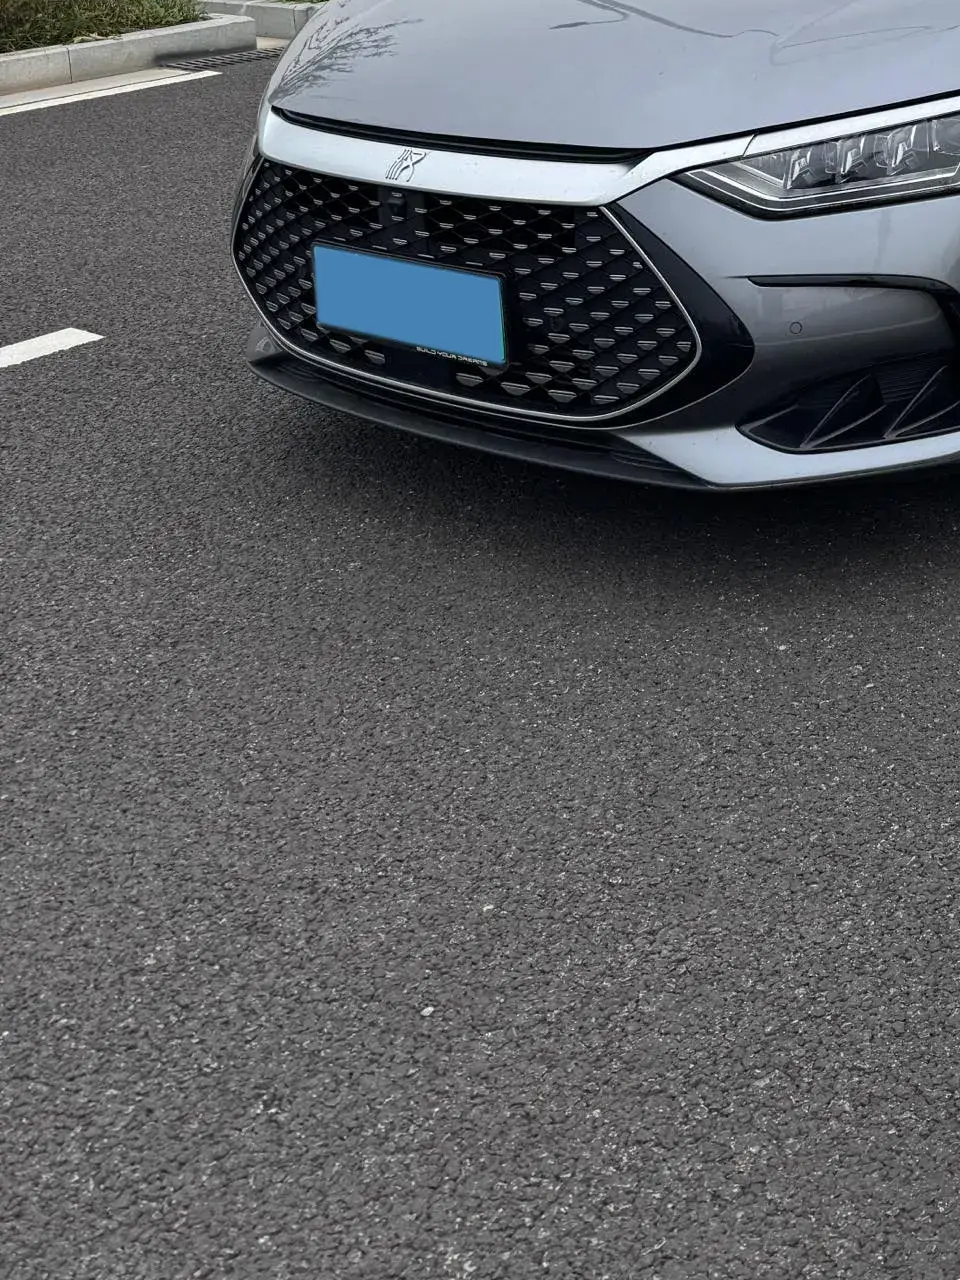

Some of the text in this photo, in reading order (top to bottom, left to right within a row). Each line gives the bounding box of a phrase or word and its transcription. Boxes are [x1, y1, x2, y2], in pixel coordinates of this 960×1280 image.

[416, 346, 488, 366] BUILD YOUR DREAMS
